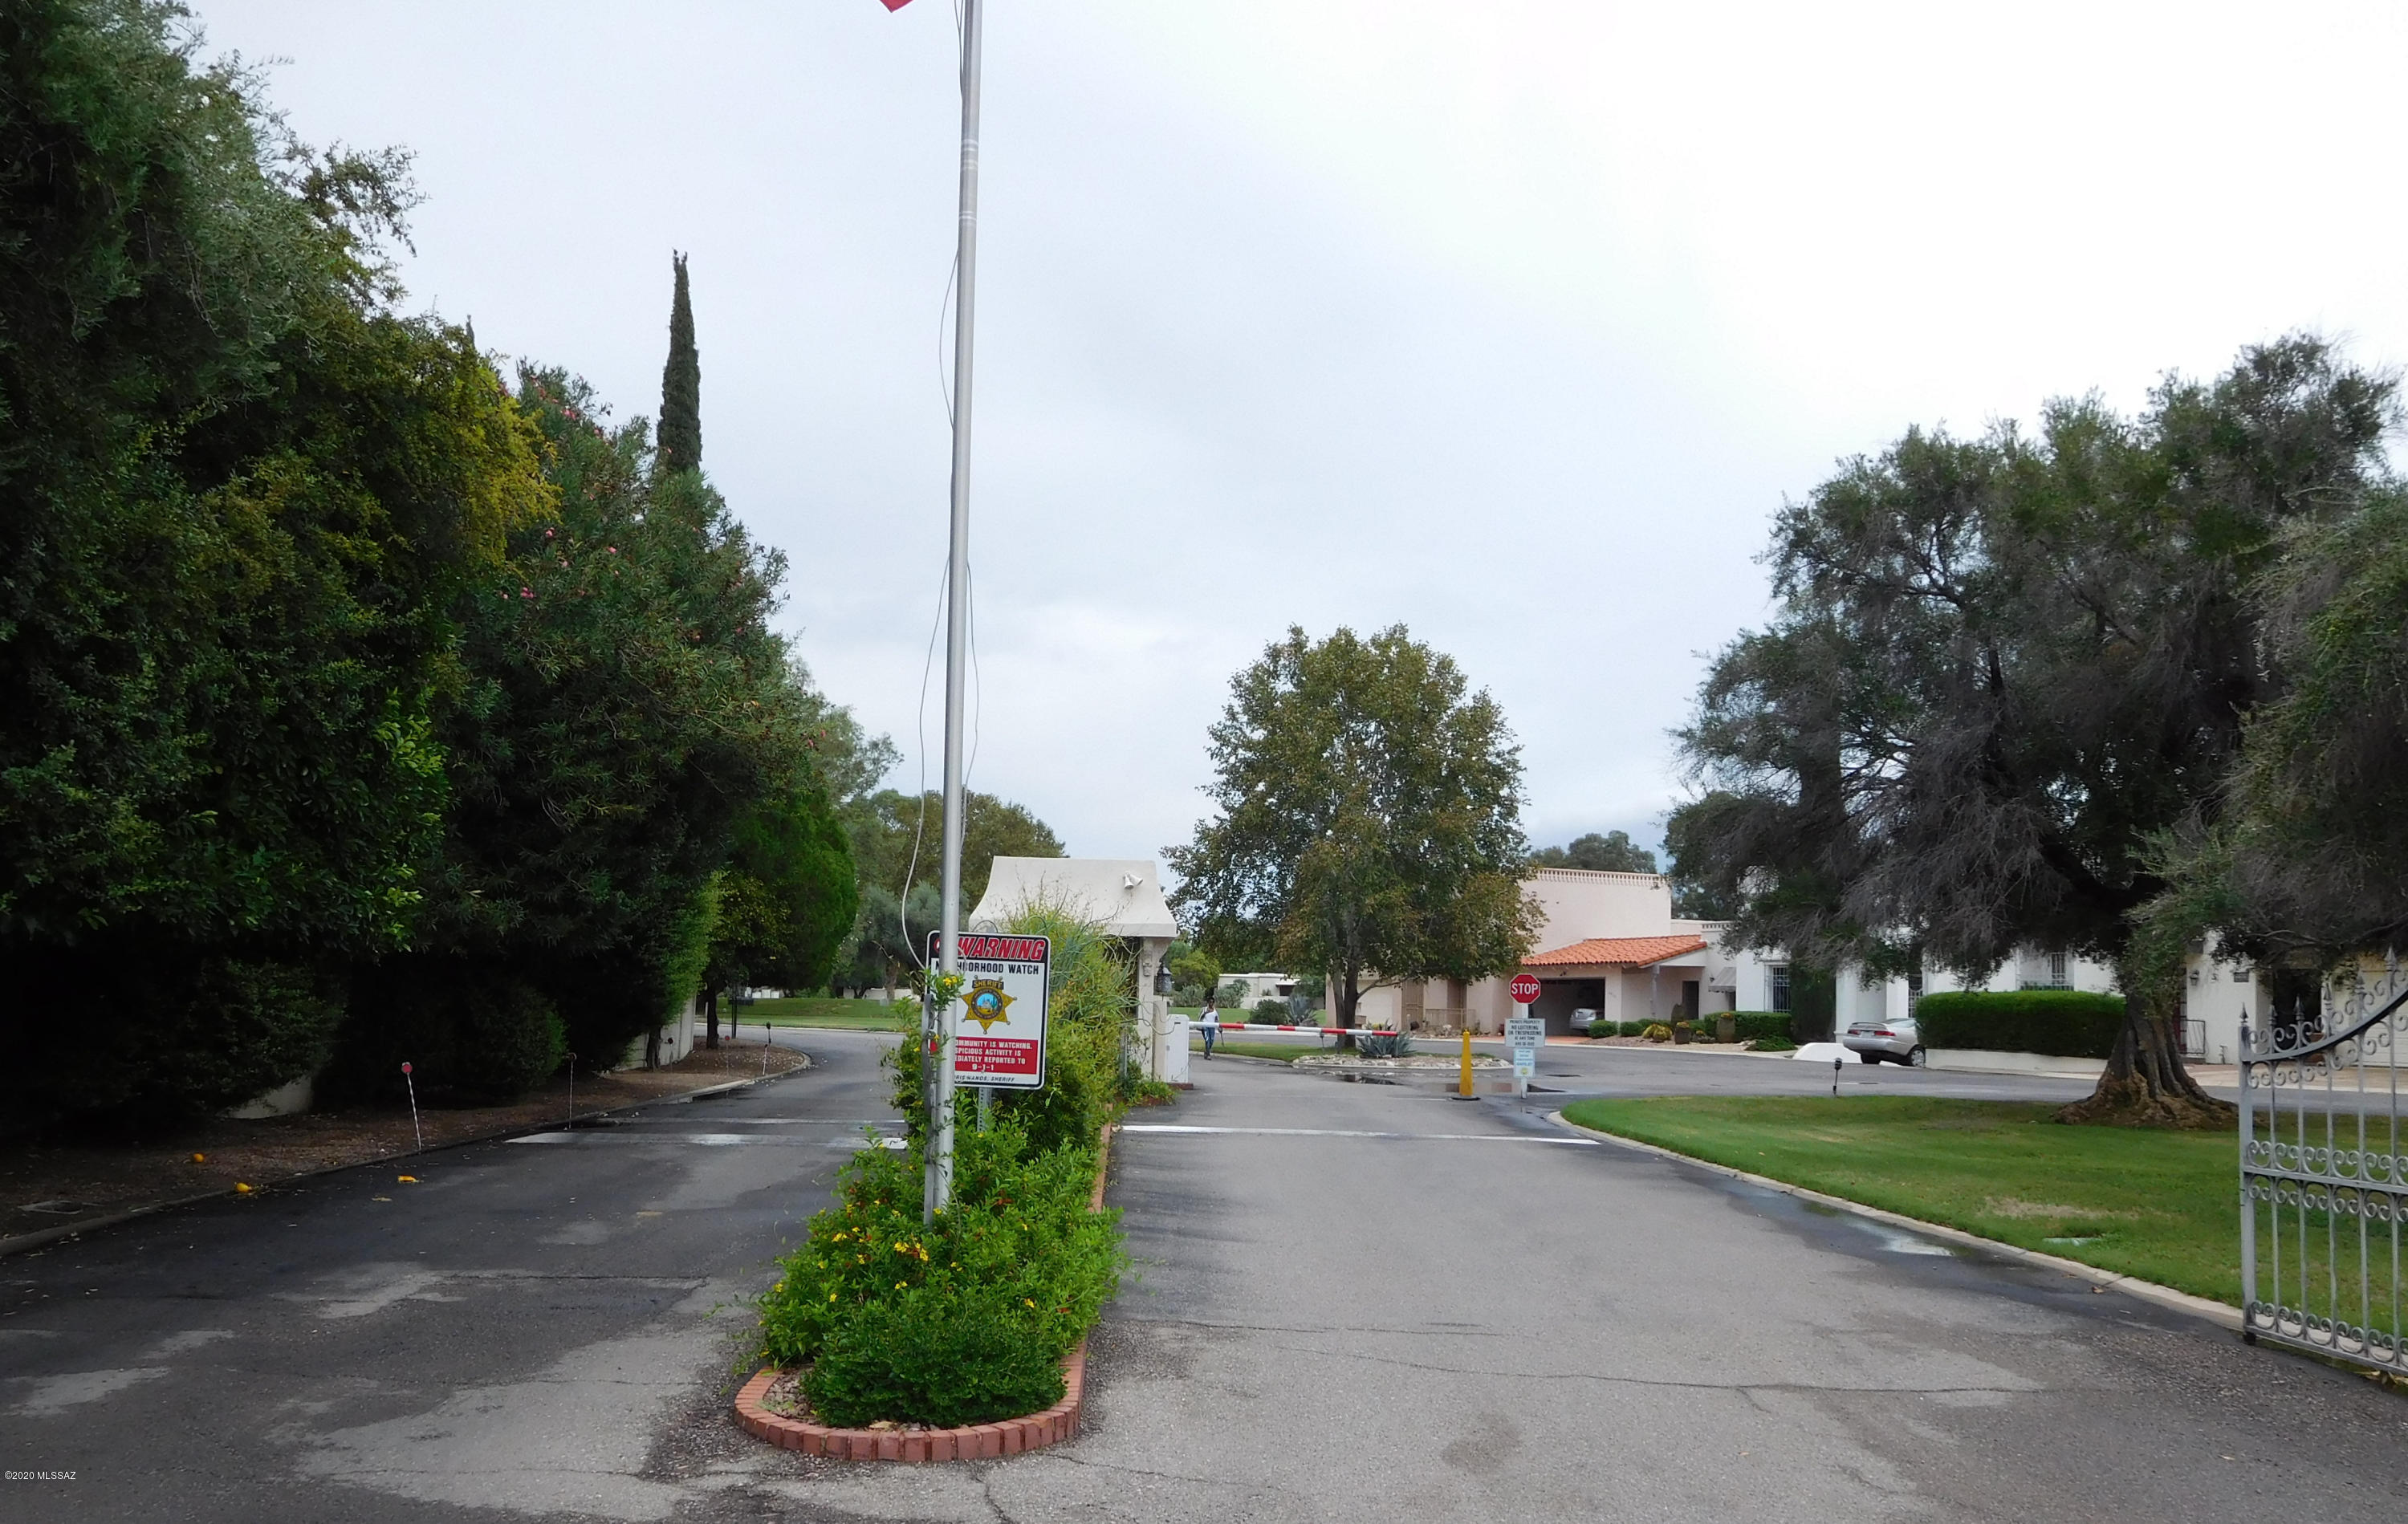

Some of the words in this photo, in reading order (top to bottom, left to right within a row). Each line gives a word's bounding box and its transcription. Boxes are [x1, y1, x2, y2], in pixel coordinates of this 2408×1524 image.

[958, 937, 1046, 961] WARNING
[1008, 964, 1039, 975] WATCH
[973, 980, 1003, 989] SHERIFF
[1511, 983, 1539, 995] STOP
